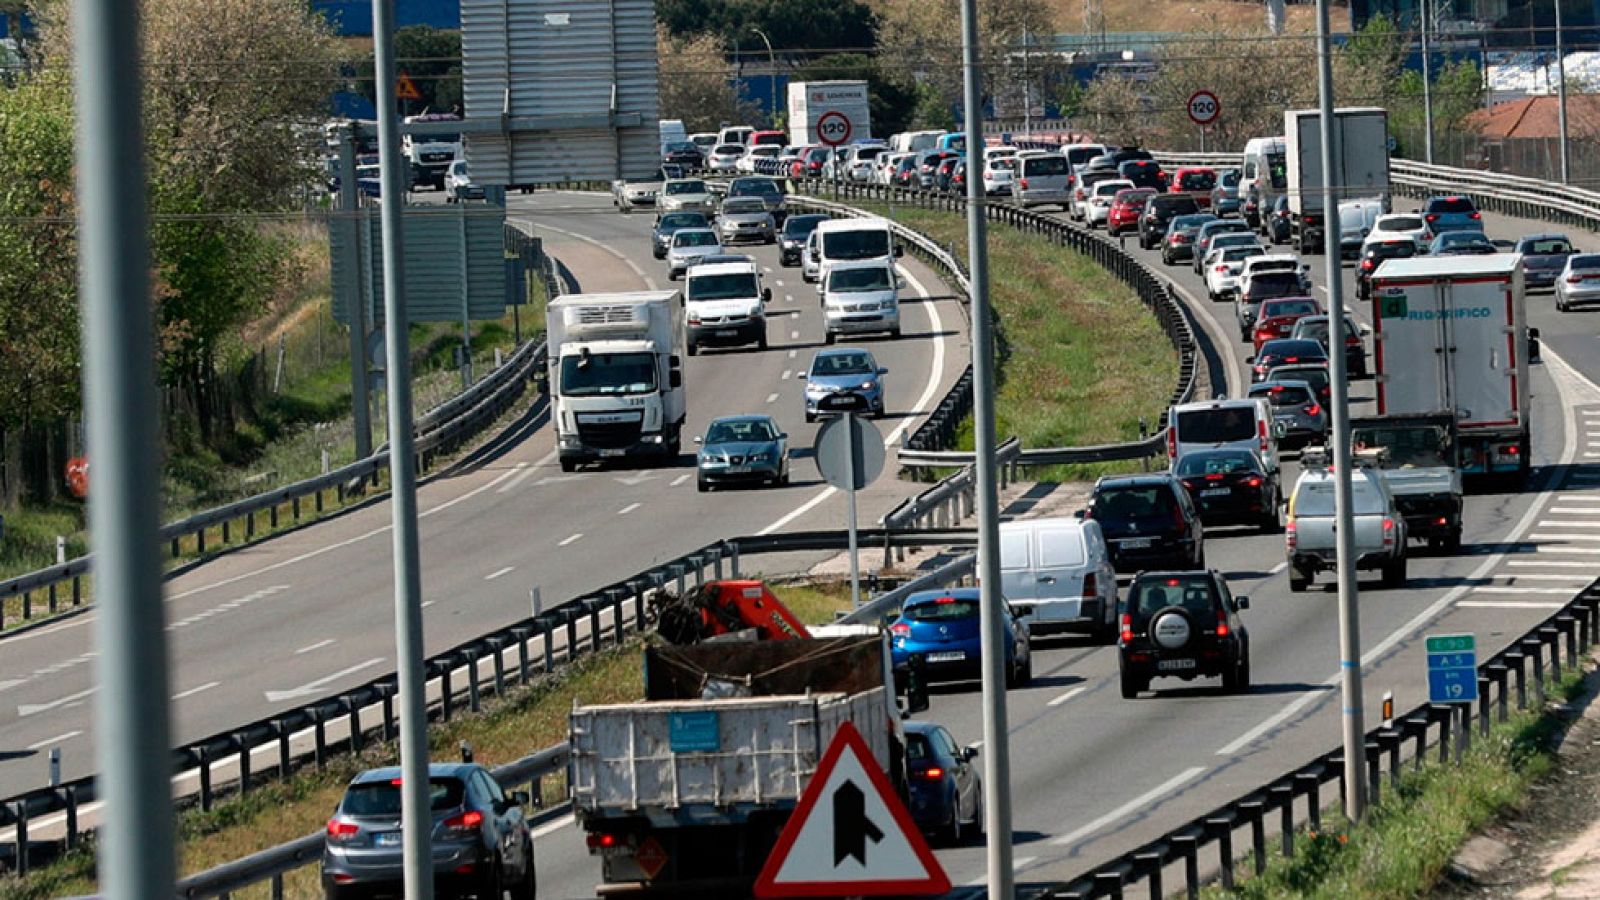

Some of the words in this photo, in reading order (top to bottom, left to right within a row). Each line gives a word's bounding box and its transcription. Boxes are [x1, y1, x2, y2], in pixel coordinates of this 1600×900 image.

[1192, 101, 1215, 114] 120
[822, 121, 846, 135] 120
[1445, 683, 1464, 698] 19
